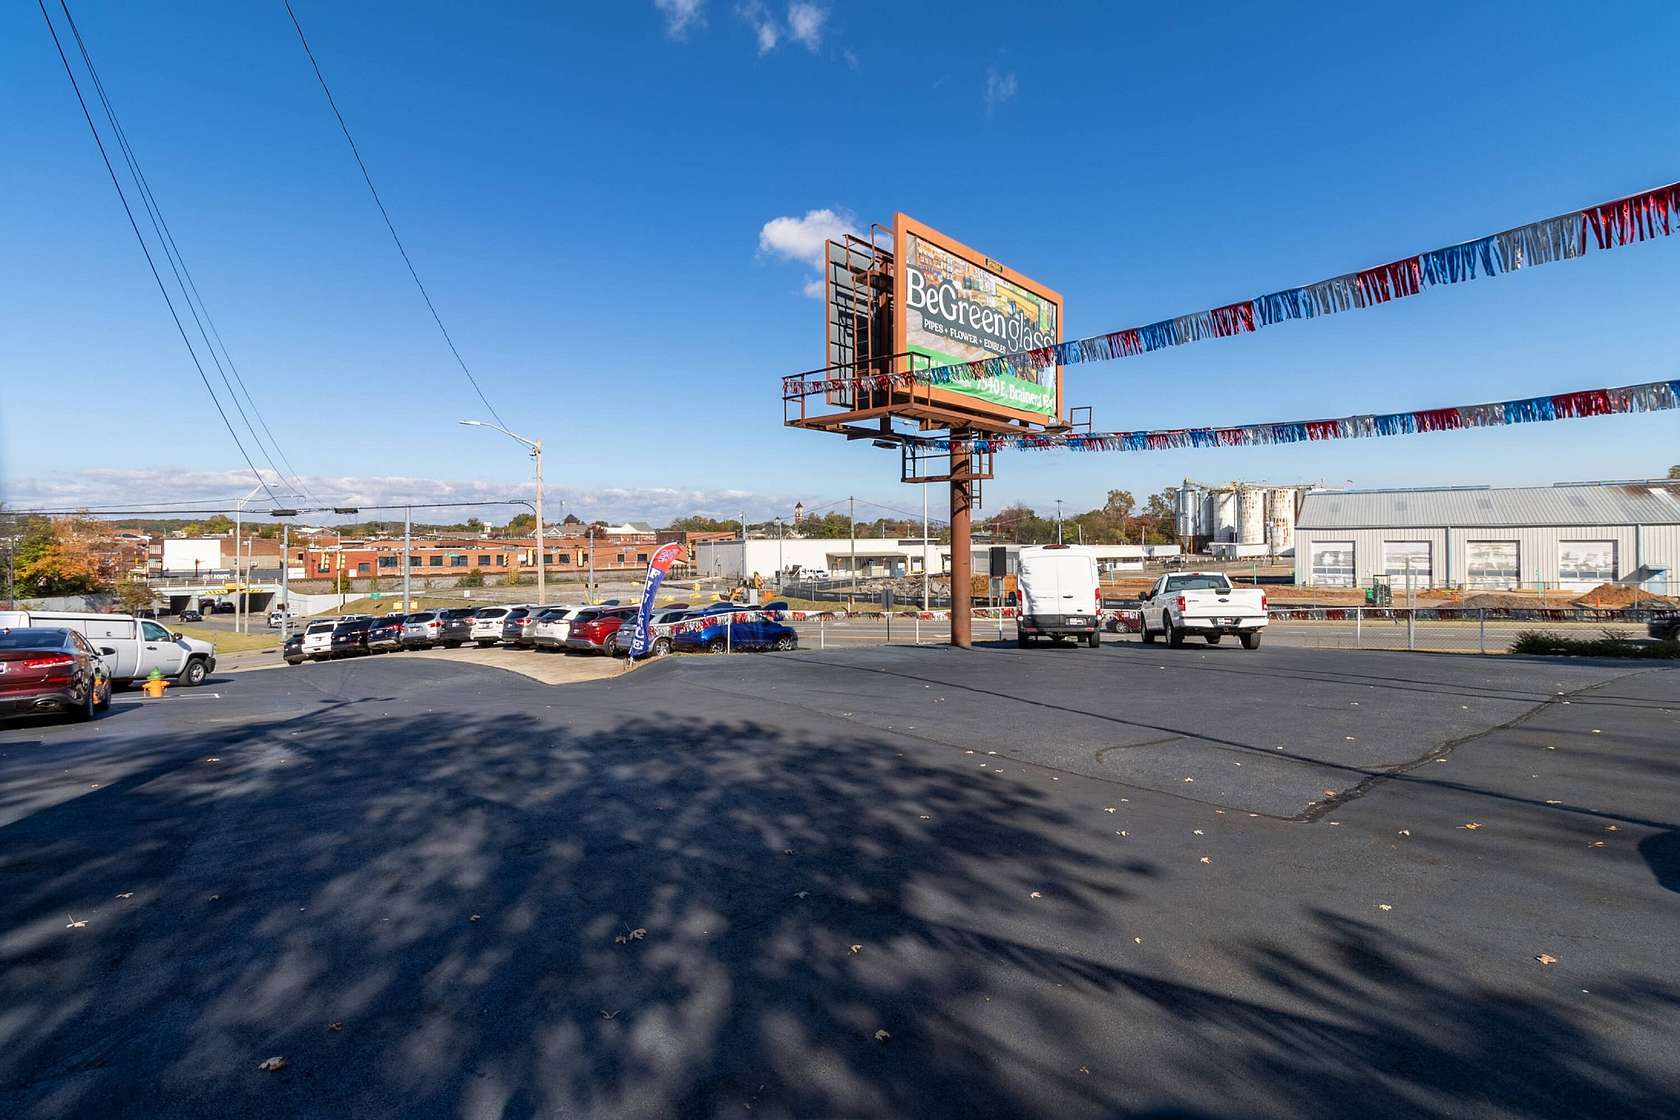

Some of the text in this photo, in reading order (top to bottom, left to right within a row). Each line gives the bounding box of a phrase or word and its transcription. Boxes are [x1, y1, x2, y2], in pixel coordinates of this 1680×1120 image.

[907, 268, 1006, 339] BeGreen
[924, 319, 1006, 353] PIPES FLOWER EDIBLES
[1009, 383, 1042, 407] Brainerd
